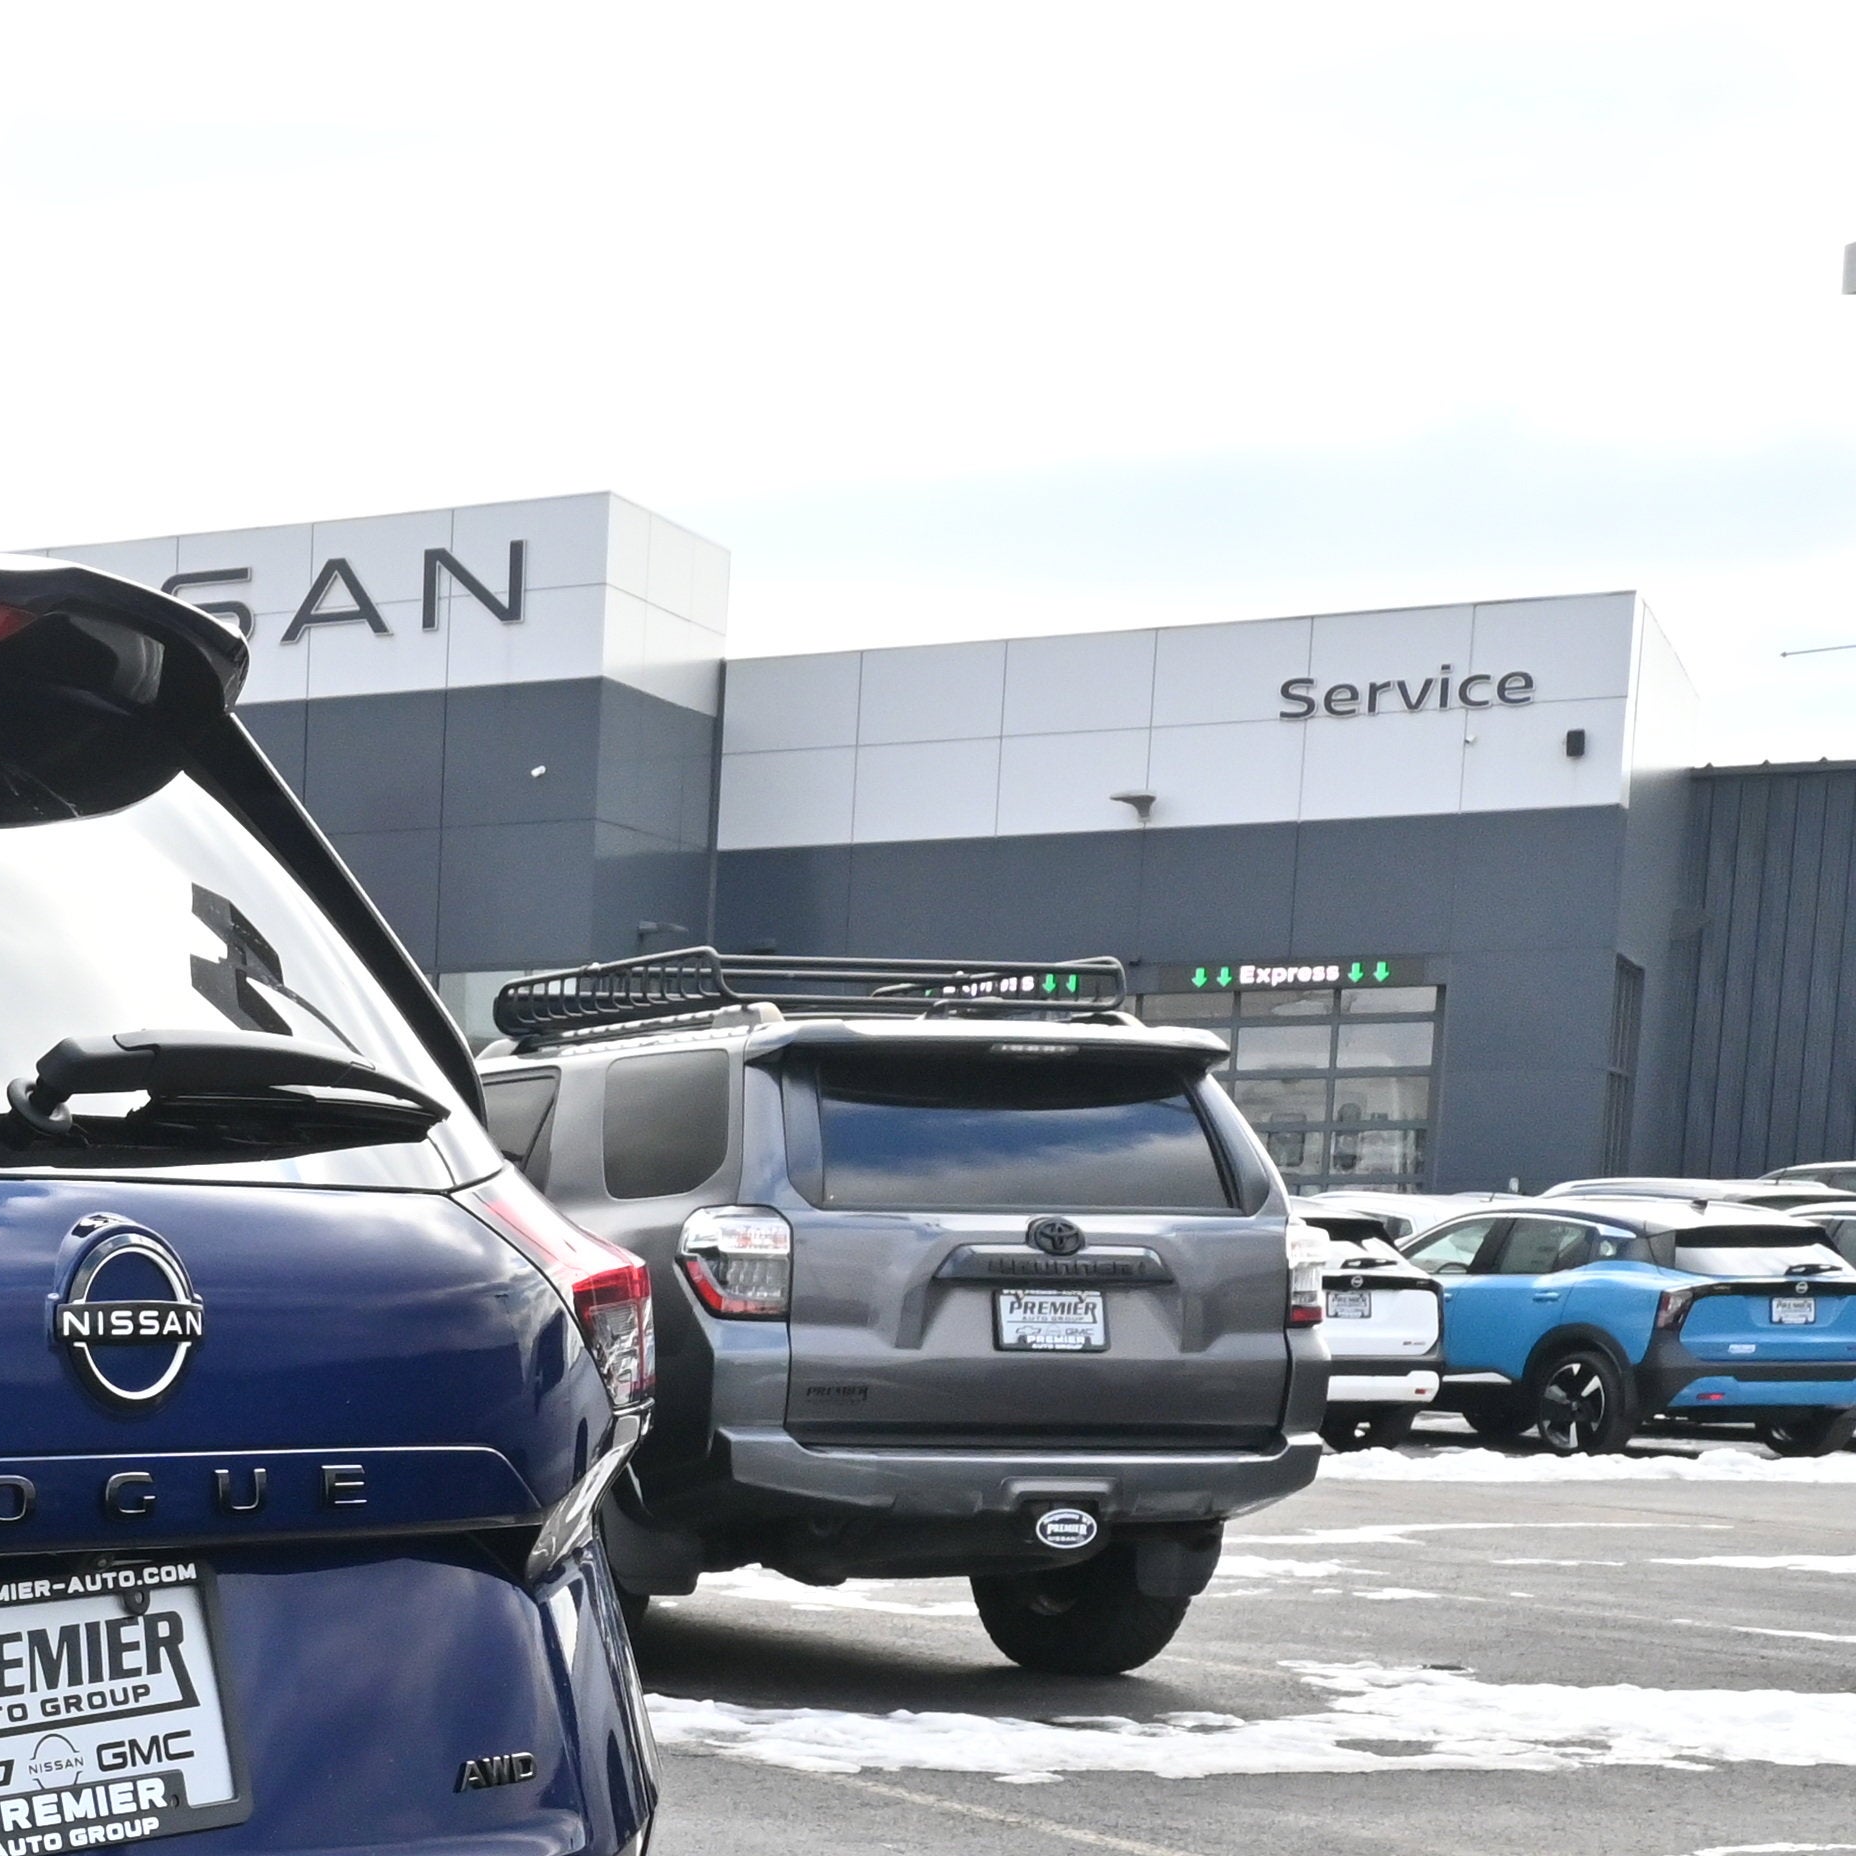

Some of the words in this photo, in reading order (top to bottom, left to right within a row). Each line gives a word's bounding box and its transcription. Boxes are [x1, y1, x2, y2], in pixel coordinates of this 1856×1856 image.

[1278, 663, 1536, 721] Service
[1239, 964, 1340, 987] Express
[62, 1308, 205, 1338] NISSAN
[1009, 1301, 1098, 1321] PREMIER
[39, 1683, 151, 1717] GROUP
[28, 1756, 84, 1775] NISSAN
[96, 1729, 196, 1772] GMC
[456, 1751, 537, 1794] AWD
[69, 1816, 161, 1847] GROUP
